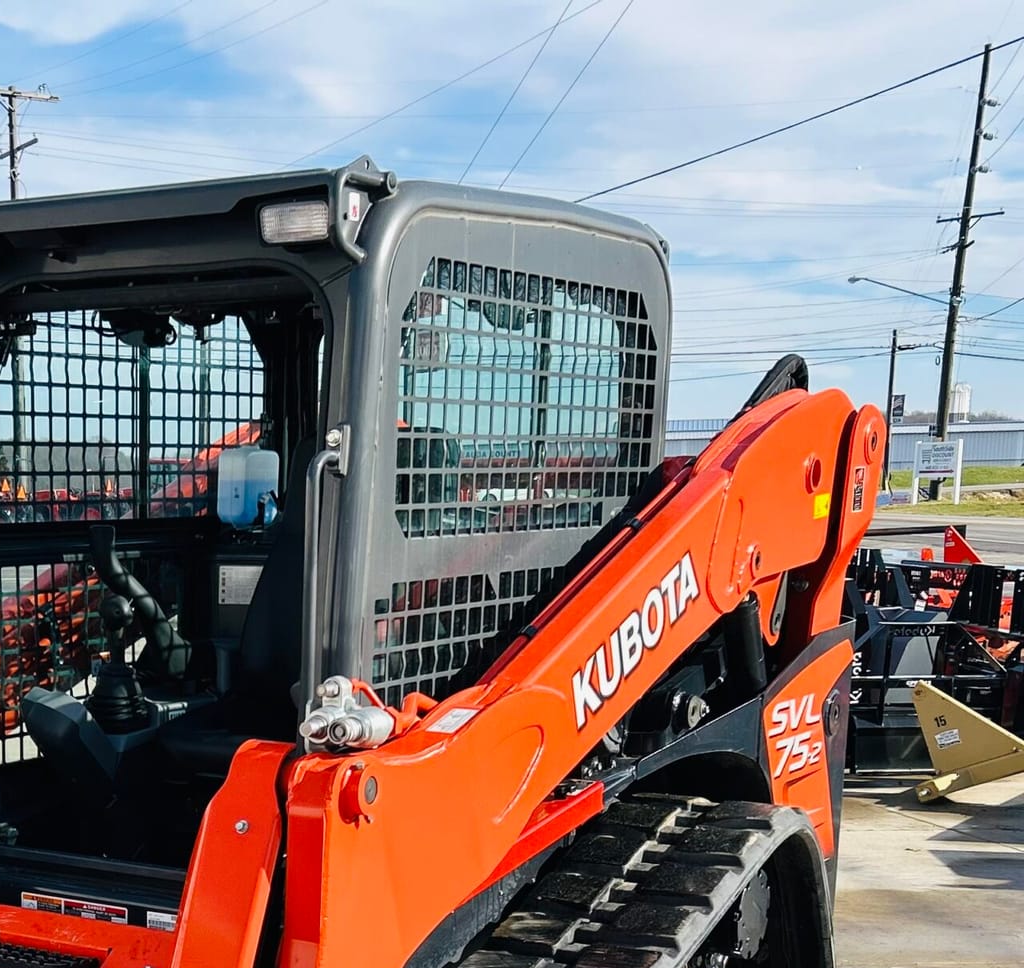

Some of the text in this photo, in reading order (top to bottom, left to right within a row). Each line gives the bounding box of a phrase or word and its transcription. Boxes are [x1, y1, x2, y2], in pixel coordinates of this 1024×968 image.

[572, 551, 700, 731] KUBOTA
[769, 694, 822, 737] SVL
[934, 715, 947, 727] 15
[774, 732, 823, 777] 75-2
